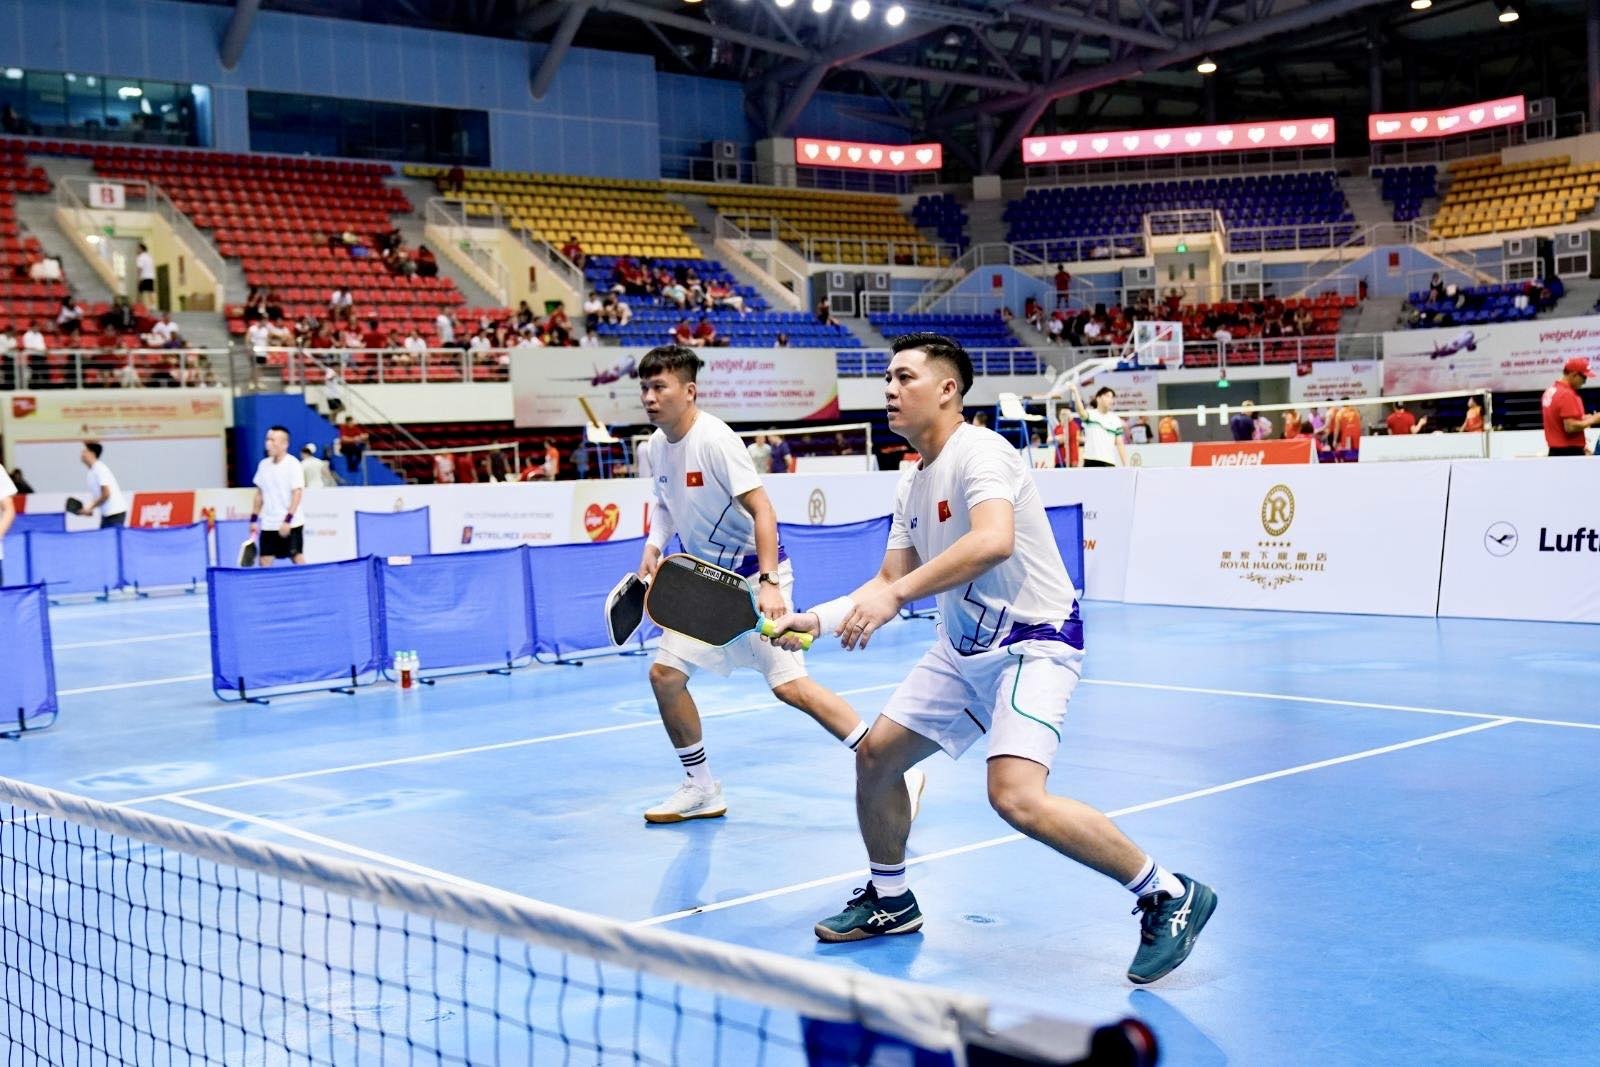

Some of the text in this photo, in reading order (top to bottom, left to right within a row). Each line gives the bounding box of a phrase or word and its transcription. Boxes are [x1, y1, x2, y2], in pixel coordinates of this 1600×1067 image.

[1538, 526, 1600, 552] Luft
[1220, 561, 1325, 572] ROYAL HALONG HOTEL
